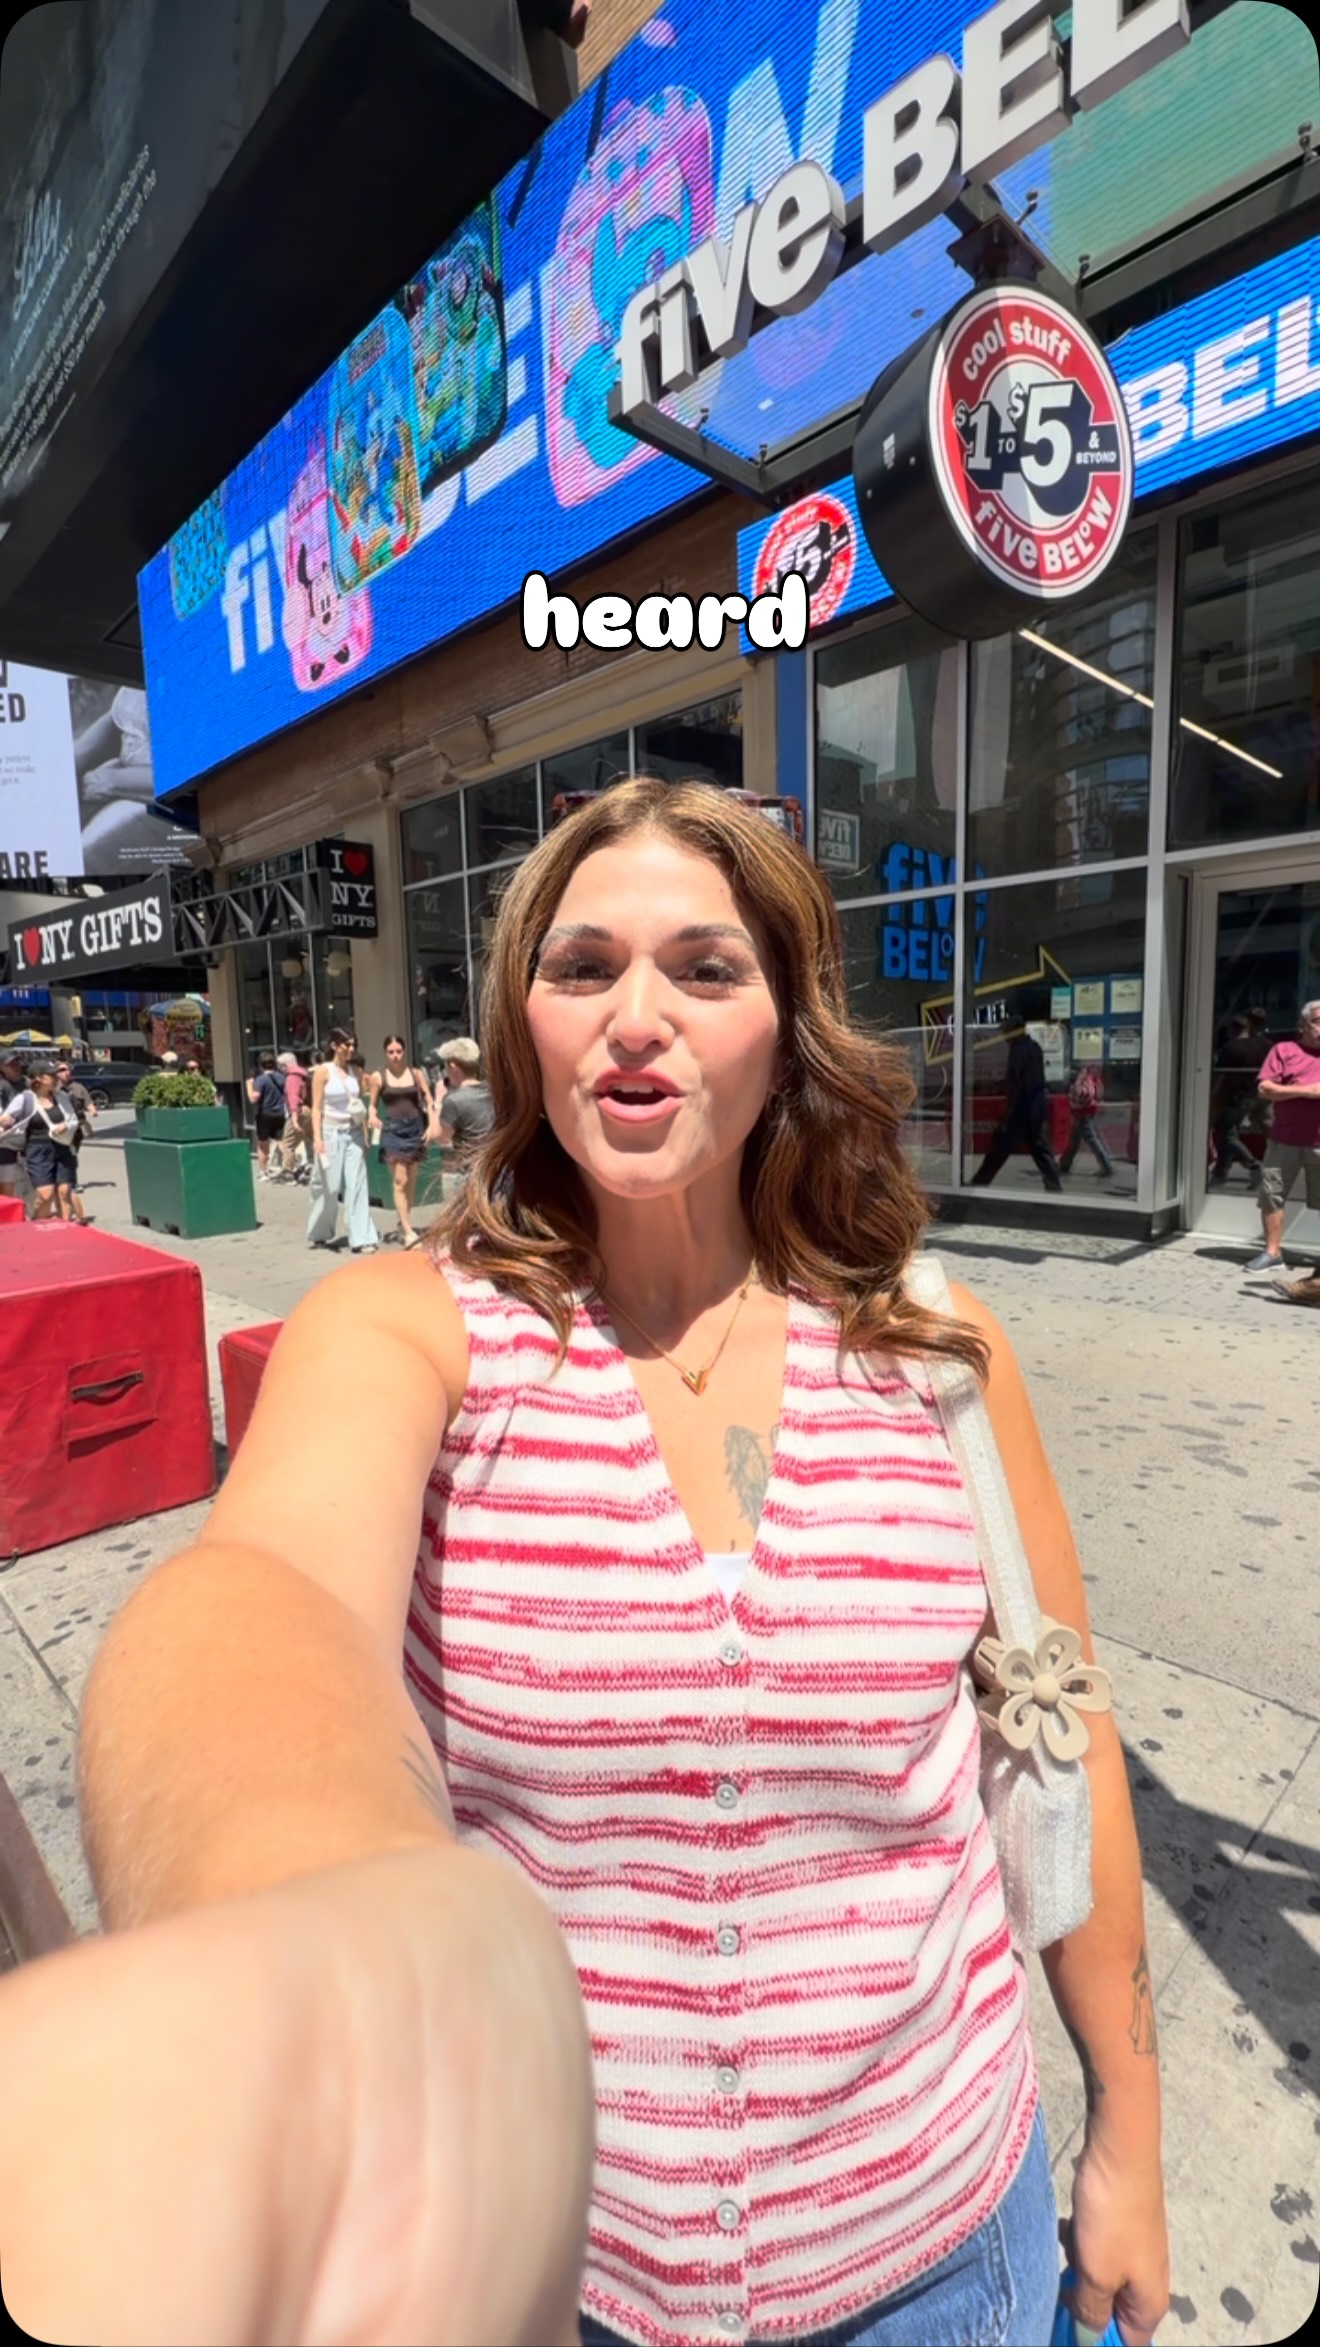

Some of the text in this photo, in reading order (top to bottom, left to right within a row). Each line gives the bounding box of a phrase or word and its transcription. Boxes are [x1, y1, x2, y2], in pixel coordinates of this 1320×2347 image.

[615, 159, 847, 418] five
[863, 0, 1190, 246] BEL
[961, 316, 1073, 381] cool stuff
[1121, 293, 1320, 466] BEL
[954, 383, 1117, 488] $1 TO $5 & BEYOND
[974, 486, 1114, 575] five BELOW
[330, 849, 344, 874] I
[14, 932, 25, 970] I
[79, 896, 163, 957] GIFTS
[331, 914, 377, 929] GIFTS
[883, 925, 987, 984] BELO
